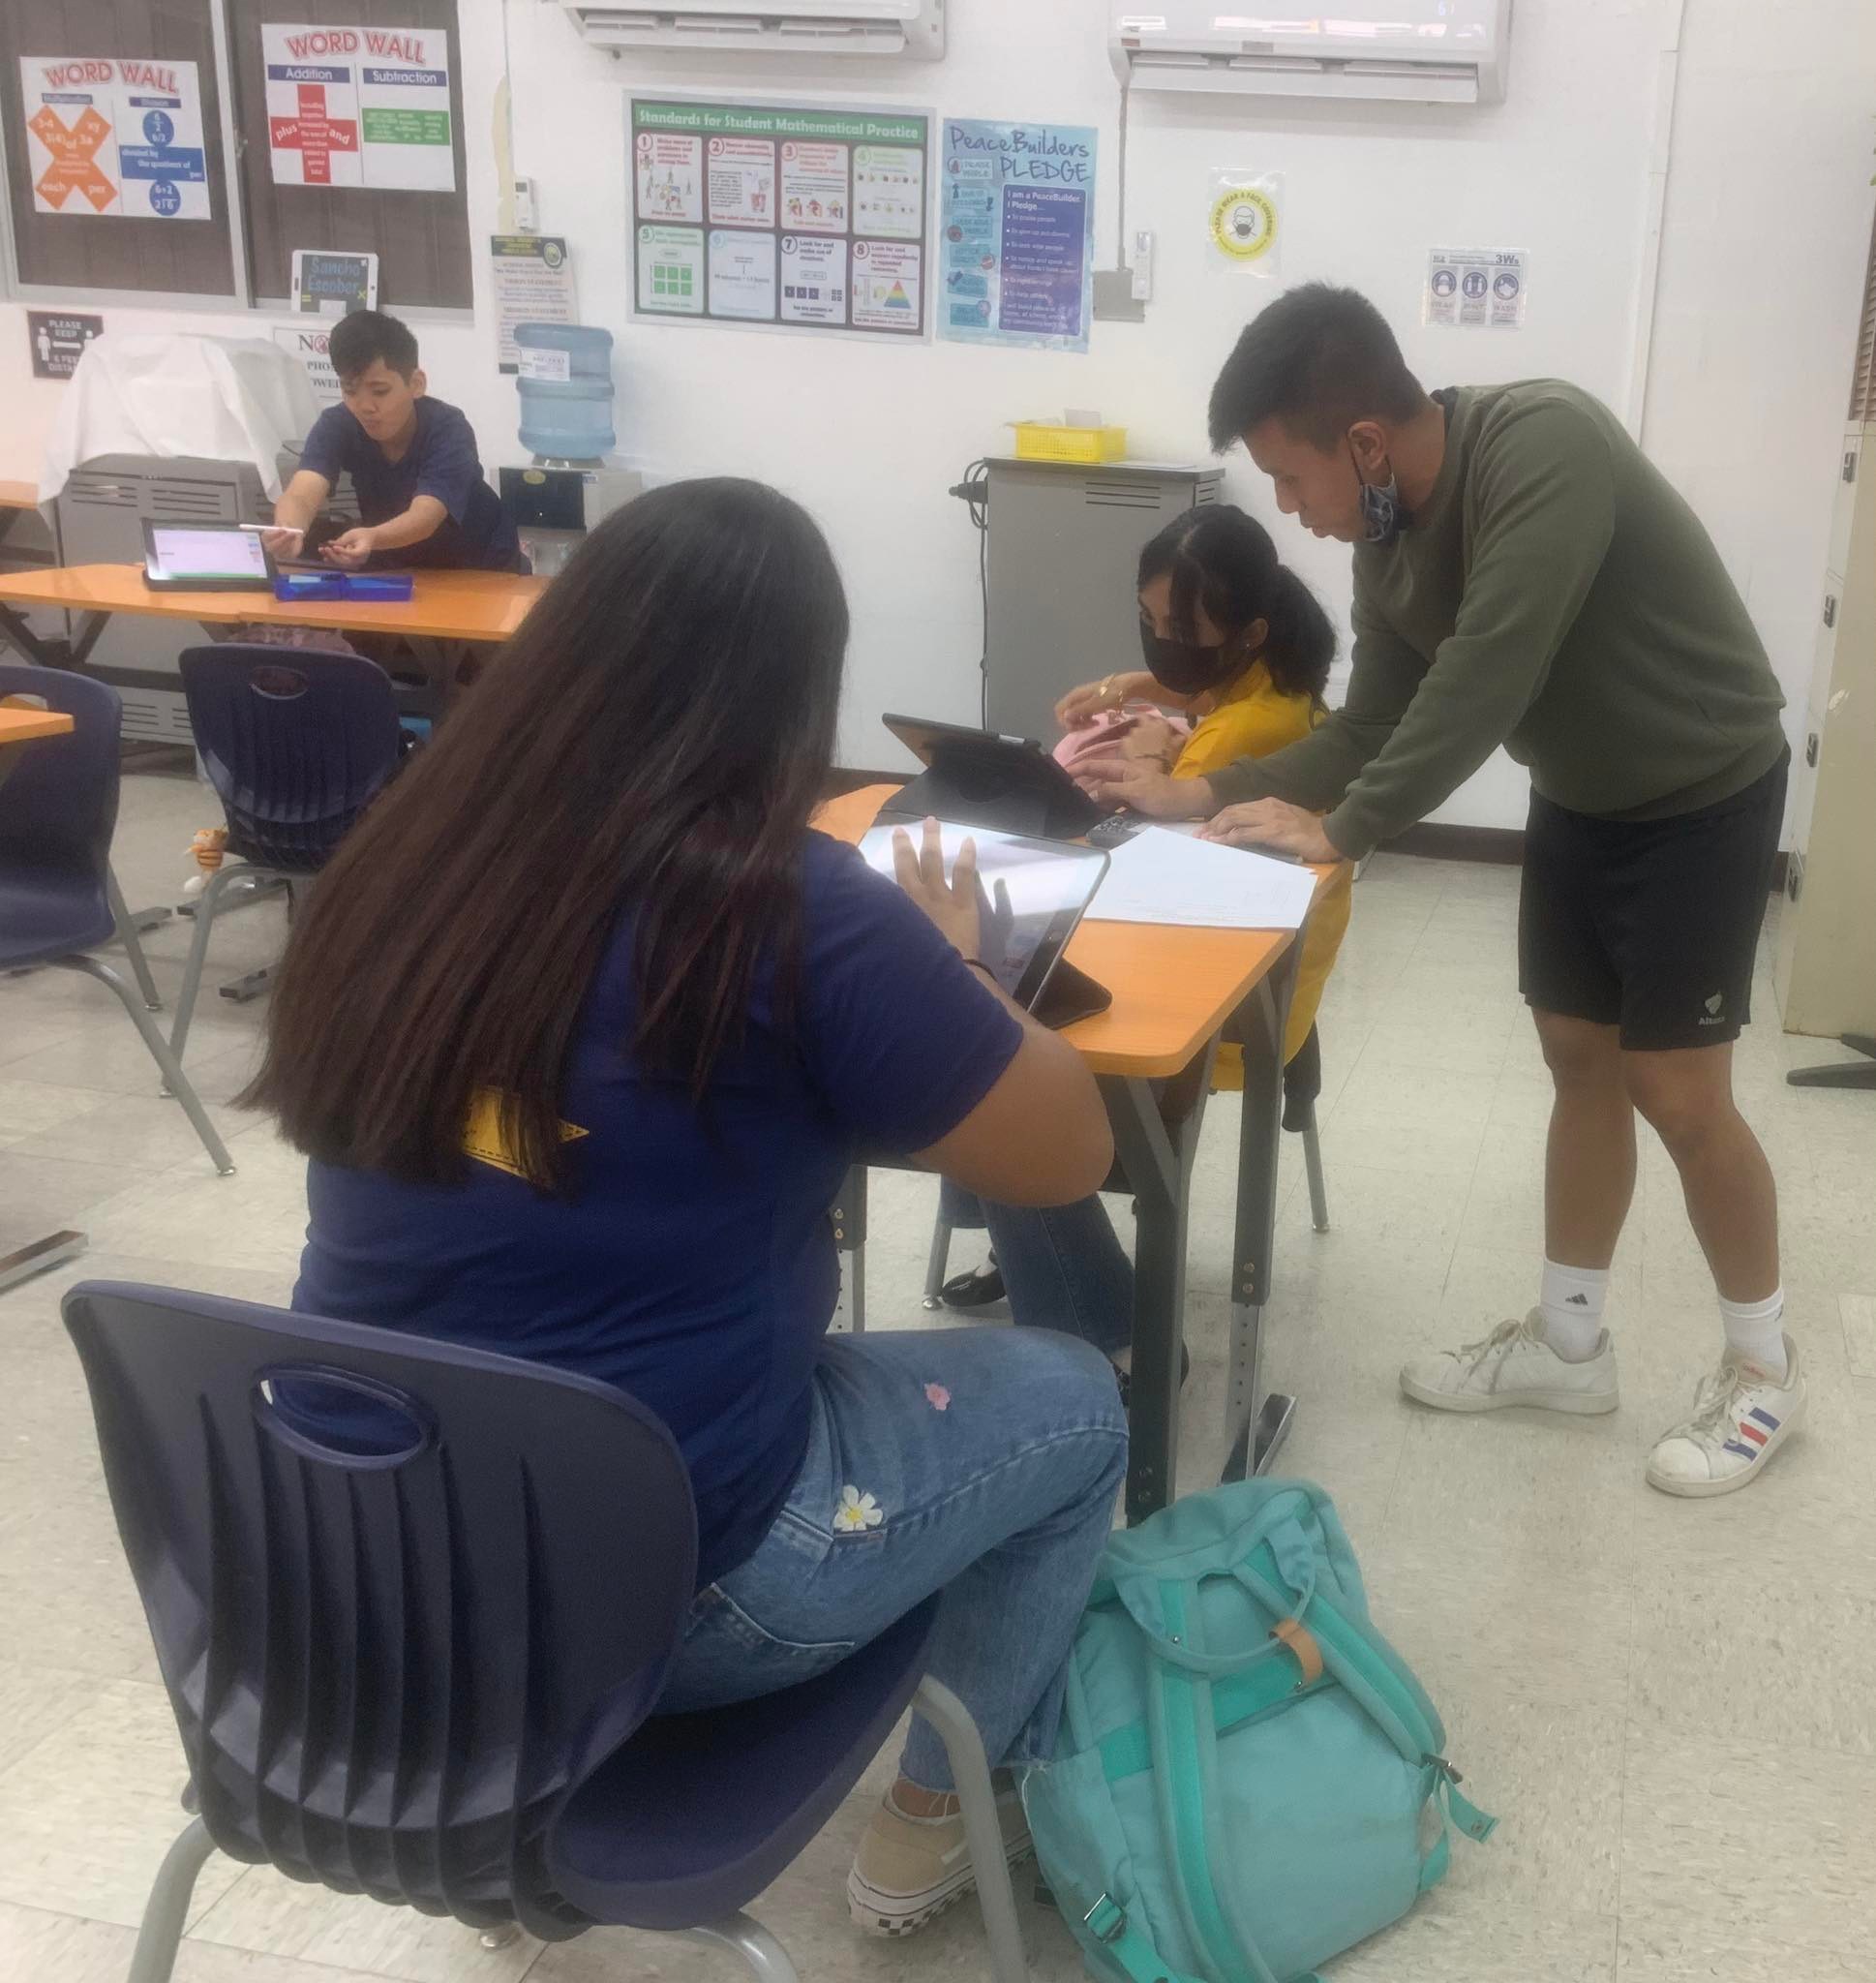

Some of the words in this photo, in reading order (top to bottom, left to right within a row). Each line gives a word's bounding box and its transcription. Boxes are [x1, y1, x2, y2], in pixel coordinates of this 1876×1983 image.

[285, 30, 359, 60] WORD
[363, 30, 426, 66] WALL
[45, 61, 113, 89] WORD
[117, 61, 179, 94] WALL
[286, 67, 333, 80] Addition
[373, 70, 438, 84] Subtraction
[275, 123, 298, 142] plus
[640, 109, 701, 126] Standards
[704, 113, 722, 127] for
[725, 114, 772, 129] Student
[775, 117, 863, 135] Mathematical
[866, 123, 919, 138] Practice
[328, 129, 350, 145] and
[950, 125, 1090, 158] PeaceBuilders
[1000, 156, 1090, 183] PLEDGE
[311, 256, 360, 277] Sancho
[48, 320, 82, 330] PLEASE
